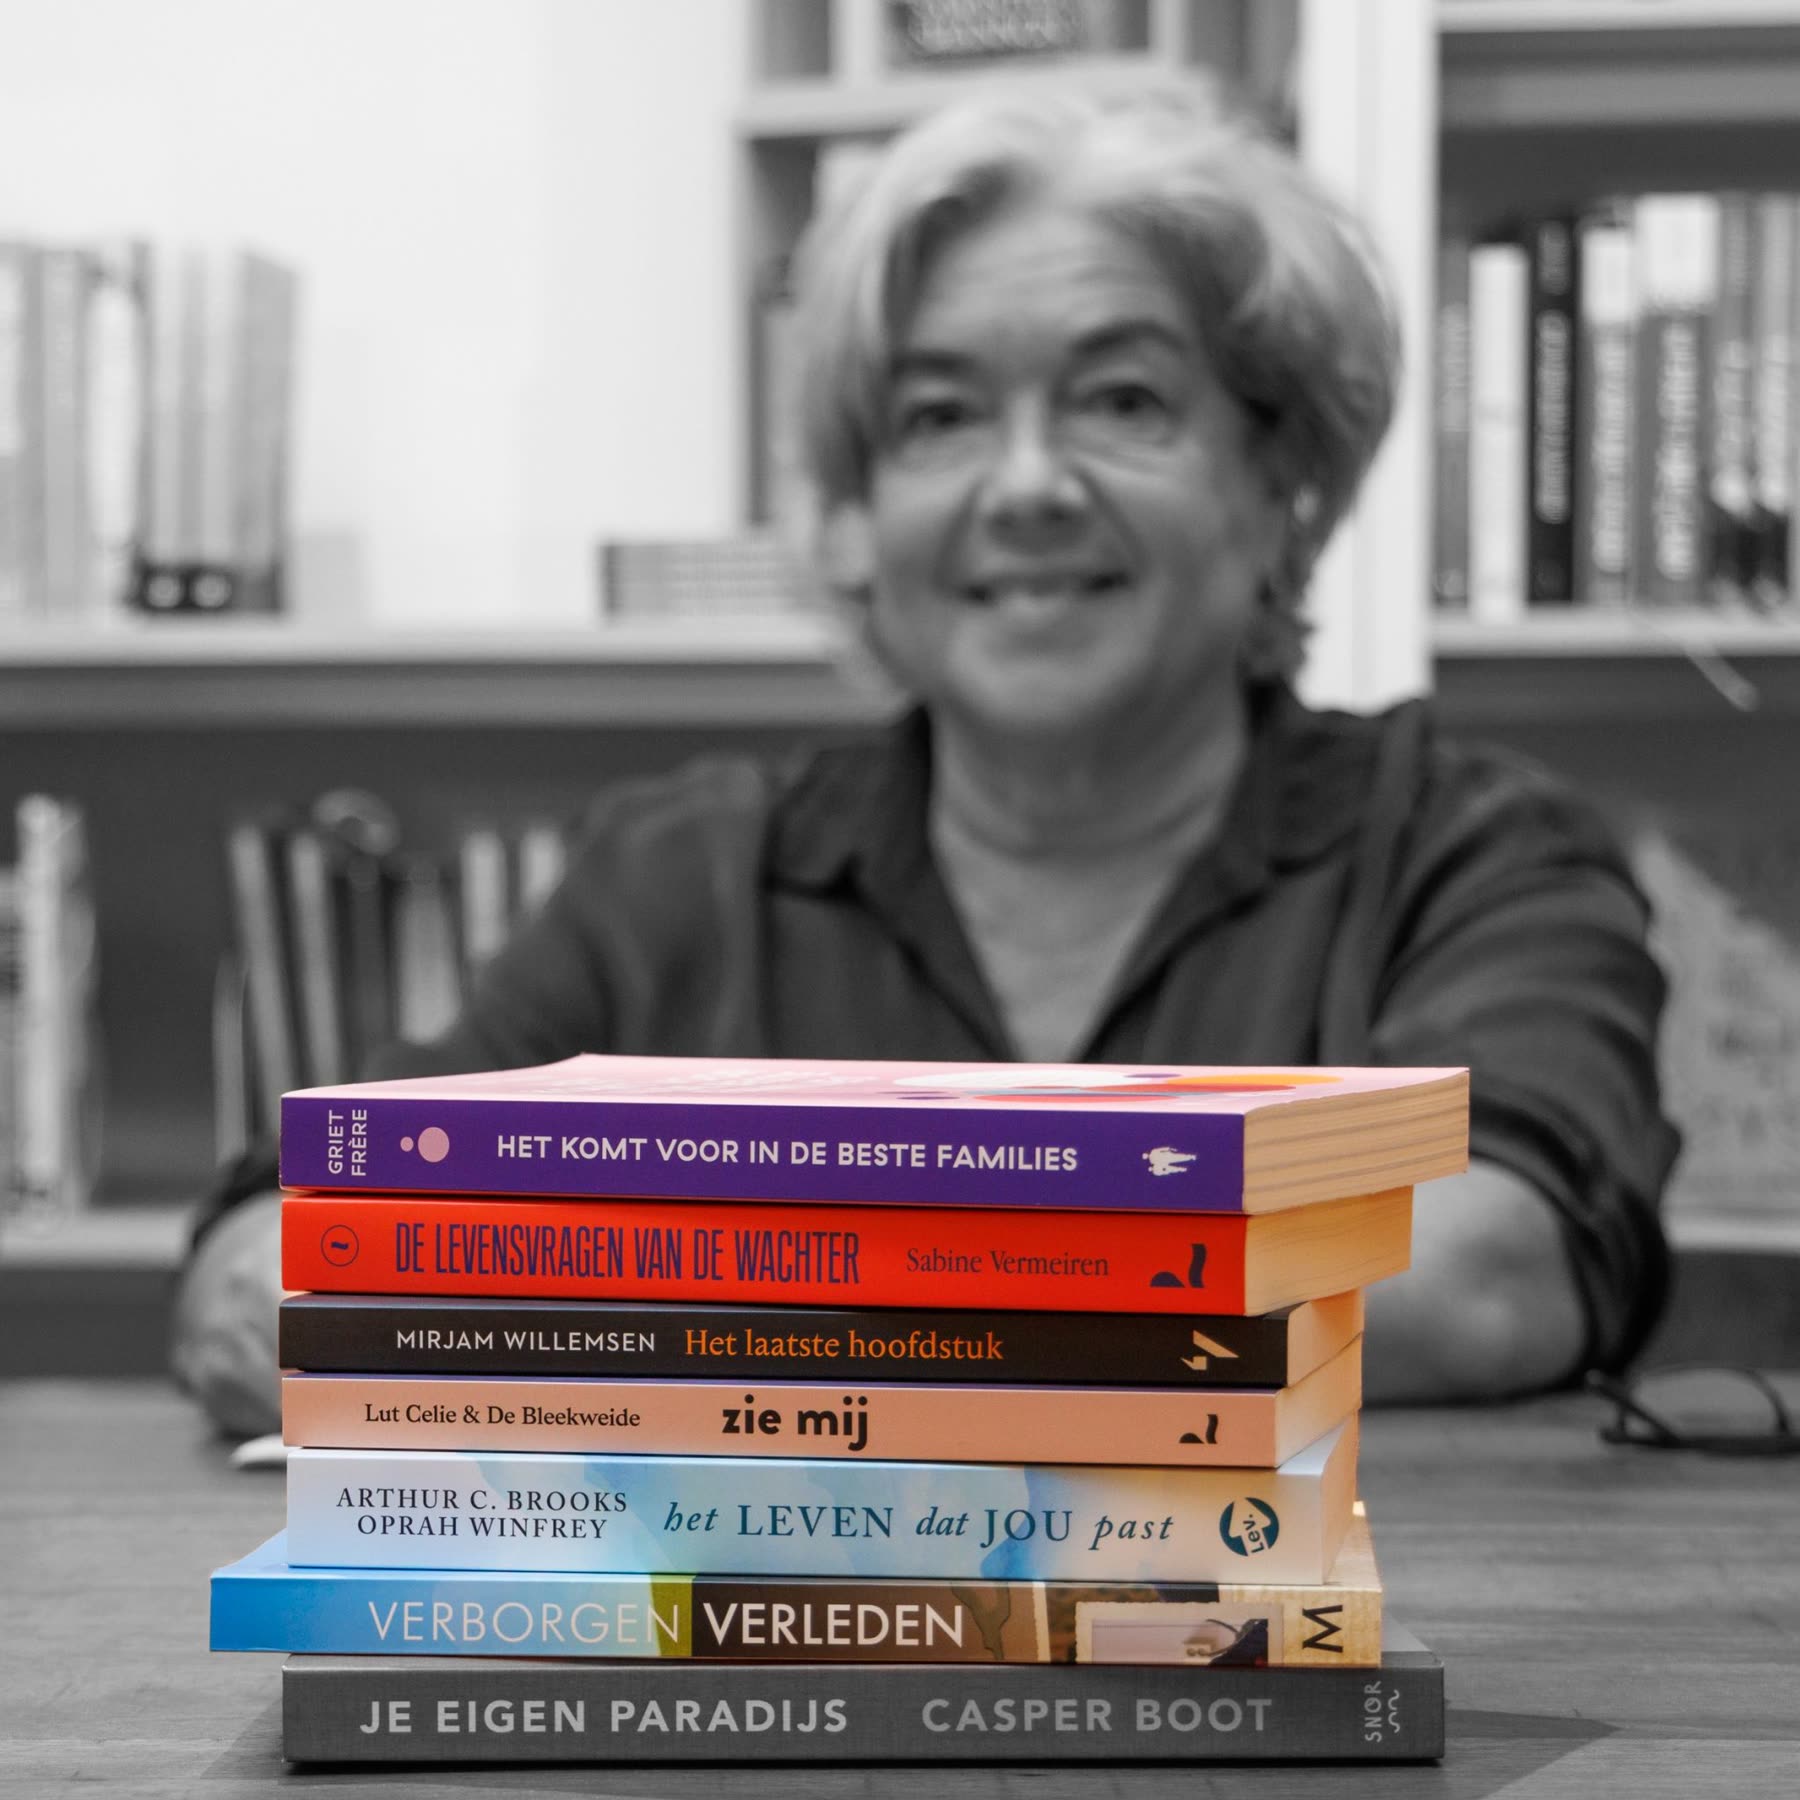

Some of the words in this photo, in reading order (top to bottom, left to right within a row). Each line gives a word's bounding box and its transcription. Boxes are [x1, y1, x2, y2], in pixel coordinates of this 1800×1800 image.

[328, 1110, 344, 1175] GRIET
[348, 1109, 368, 1176] FRÈRE
[497, 1135, 552, 1159] HET
[561, 1136, 647, 1161] KOMT
[655, 1138, 739, 1163] VOOR
[749, 1141, 779, 1165] IN
[791, 1142, 826, 1166] DE
[838, 1143, 926, 1168] BESTE
[937, 1145, 1078, 1172] FAMILIES
[396, 1222, 424, 1273] DE
[435, 1223, 624, 1277] LEVENSVRAGEN
[633, 1228, 683, 1280] VAN
[693, 1229, 724, 1281] DE
[735, 1230, 859, 1285] WACHTER
[906, 1247, 982, 1273] Sabine
[989, 1250, 1109, 1277] Vermeiren
[397, 1330, 494, 1351] MIRJAM
[503, 1331, 655, 1352] WILLEMSEN
[685, 1328, 736, 1356] Het
[745, 1329, 840, 1358] laatste
[848, 1330, 1003, 1361] hoofdstuk
[365, 1404, 400, 1423] Lut
[405, 1404, 456, 1424] Celie
[462, 1406, 481, 1425] &
[487, 1406, 515, 1425] De
[522, 1406, 641, 1427] Bleekweide
[722, 1394, 781, 1435] zie
[797, 1395, 868, 1451] mij
[336, 1487, 459, 1509] ARTHUR
[470, 1489, 497, 1511] C.
[507, 1490, 627, 1512] BROOKS
[357, 1514, 459, 1537] OPRAH
[469, 1517, 607, 1540] WINFREY
[663, 1502, 719, 1533] het
[737, 1505, 894, 1538] LEVEN
[915, 1506, 969, 1537] dat
[981, 1510, 1073, 1549] JOU
[1090, 1514, 1174, 1553] past
[368, 1602, 679, 1644] VERBORGEN
[703, 1603, 964, 1648] VERLEDEN
[360, 1701, 411, 1734] JE
[437, 1700, 585, 1733] EIGEN
[611, 1700, 847, 1736] PARADIJS
[922, 1697, 1112, 1732] CASPER
[1136, 1697, 1273, 1733] BOOT
[1364, 1680, 1383, 1743] SNOR
